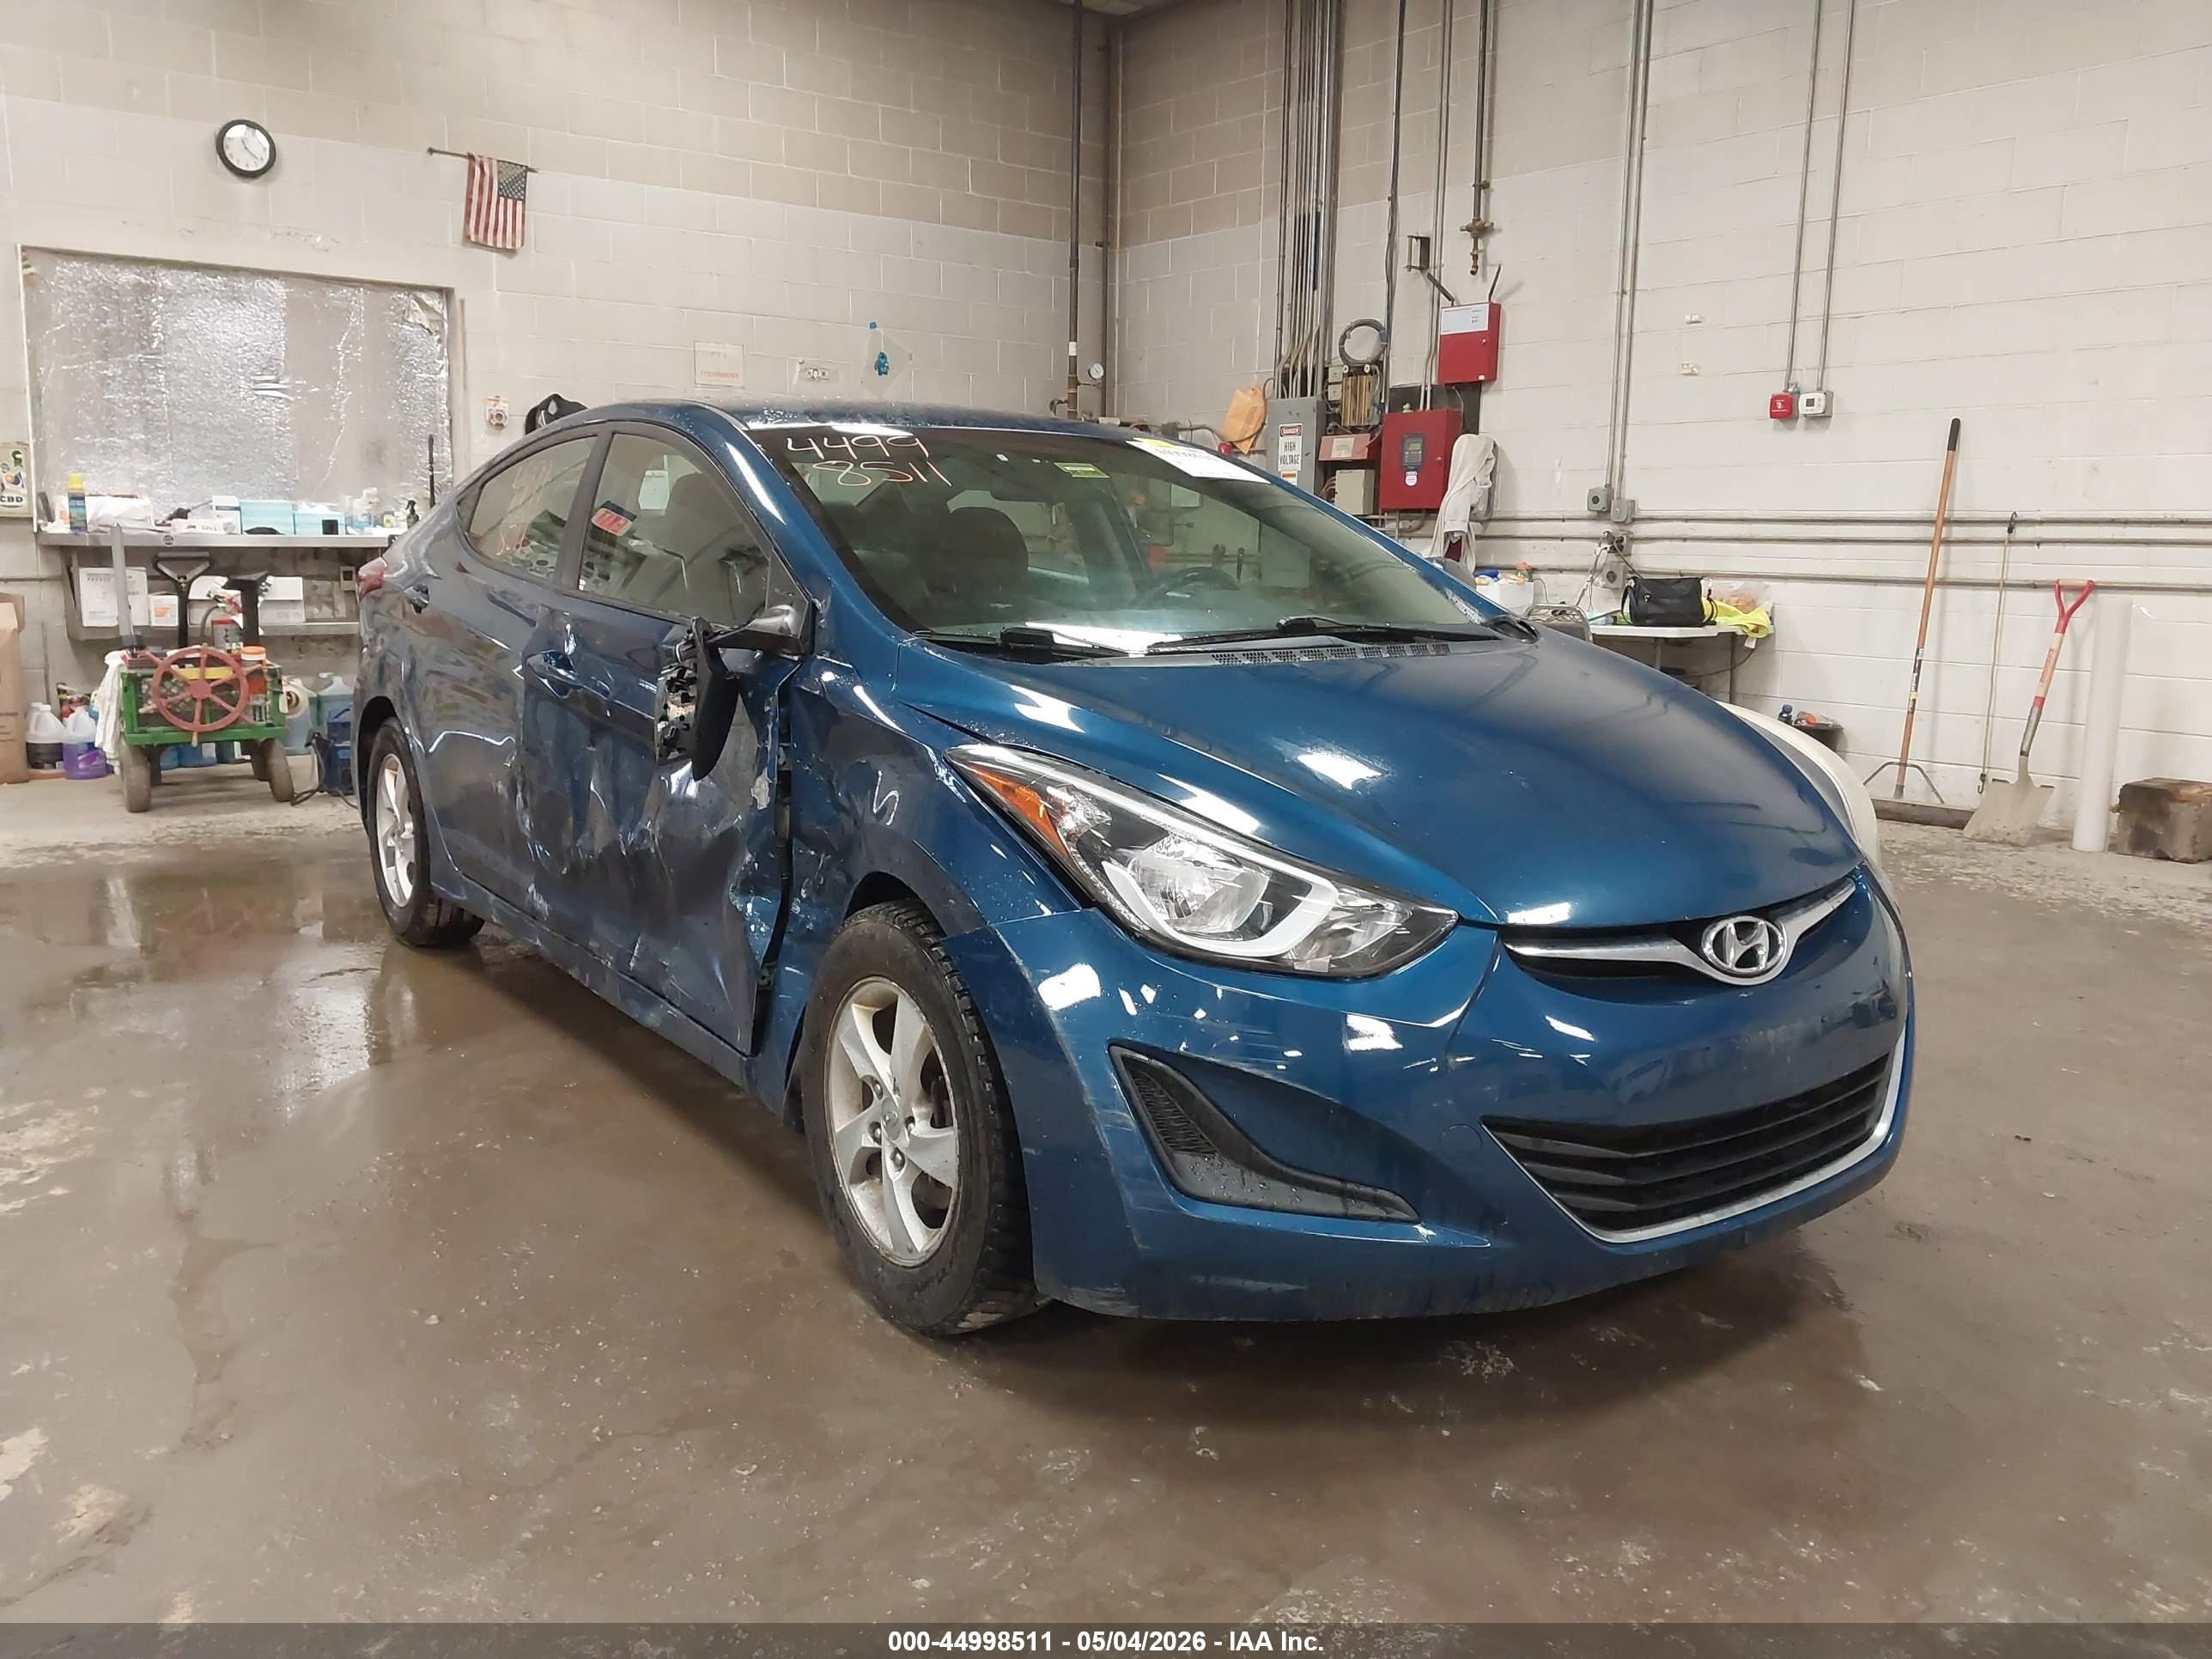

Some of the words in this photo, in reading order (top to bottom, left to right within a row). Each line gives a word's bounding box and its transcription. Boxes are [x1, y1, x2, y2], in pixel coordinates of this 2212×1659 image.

[787, 434, 930, 460] 4499
[1284, 441, 1297, 453] HIGH
[1279, 454, 1300, 465] VOLTAGE
[812, 459, 953, 488] 8511
